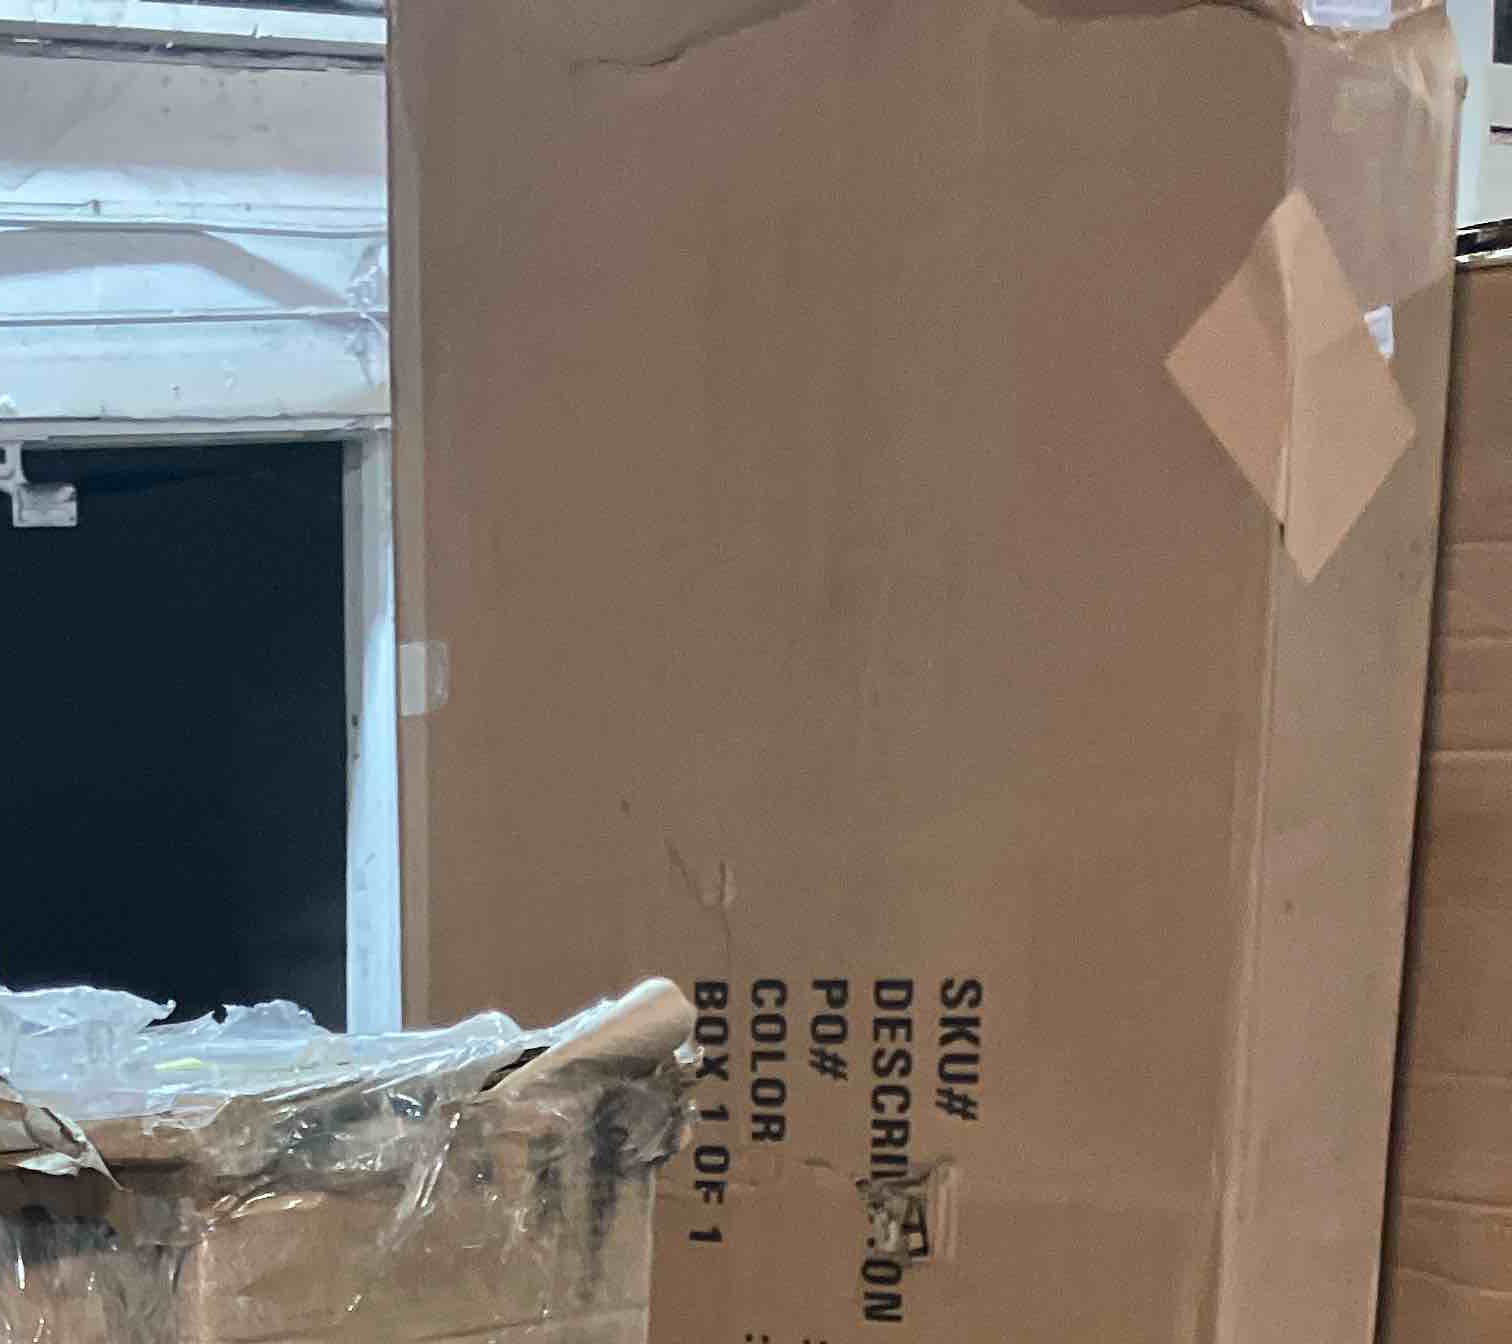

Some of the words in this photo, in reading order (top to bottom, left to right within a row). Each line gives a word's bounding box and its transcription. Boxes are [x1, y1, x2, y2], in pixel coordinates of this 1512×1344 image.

[694, 980, 729, 1081] BOX
[750, 978, 787, 1142] COLOR
[809, 977, 848, 1083] PO#
[936, 977, 982, 1122] SKU#
[698, 1104, 729, 1121] 1
[860, 978, 915, 1324] DESCRION
[694, 1145, 730, 1204] OF
[689, 1226, 722, 1243] 1
